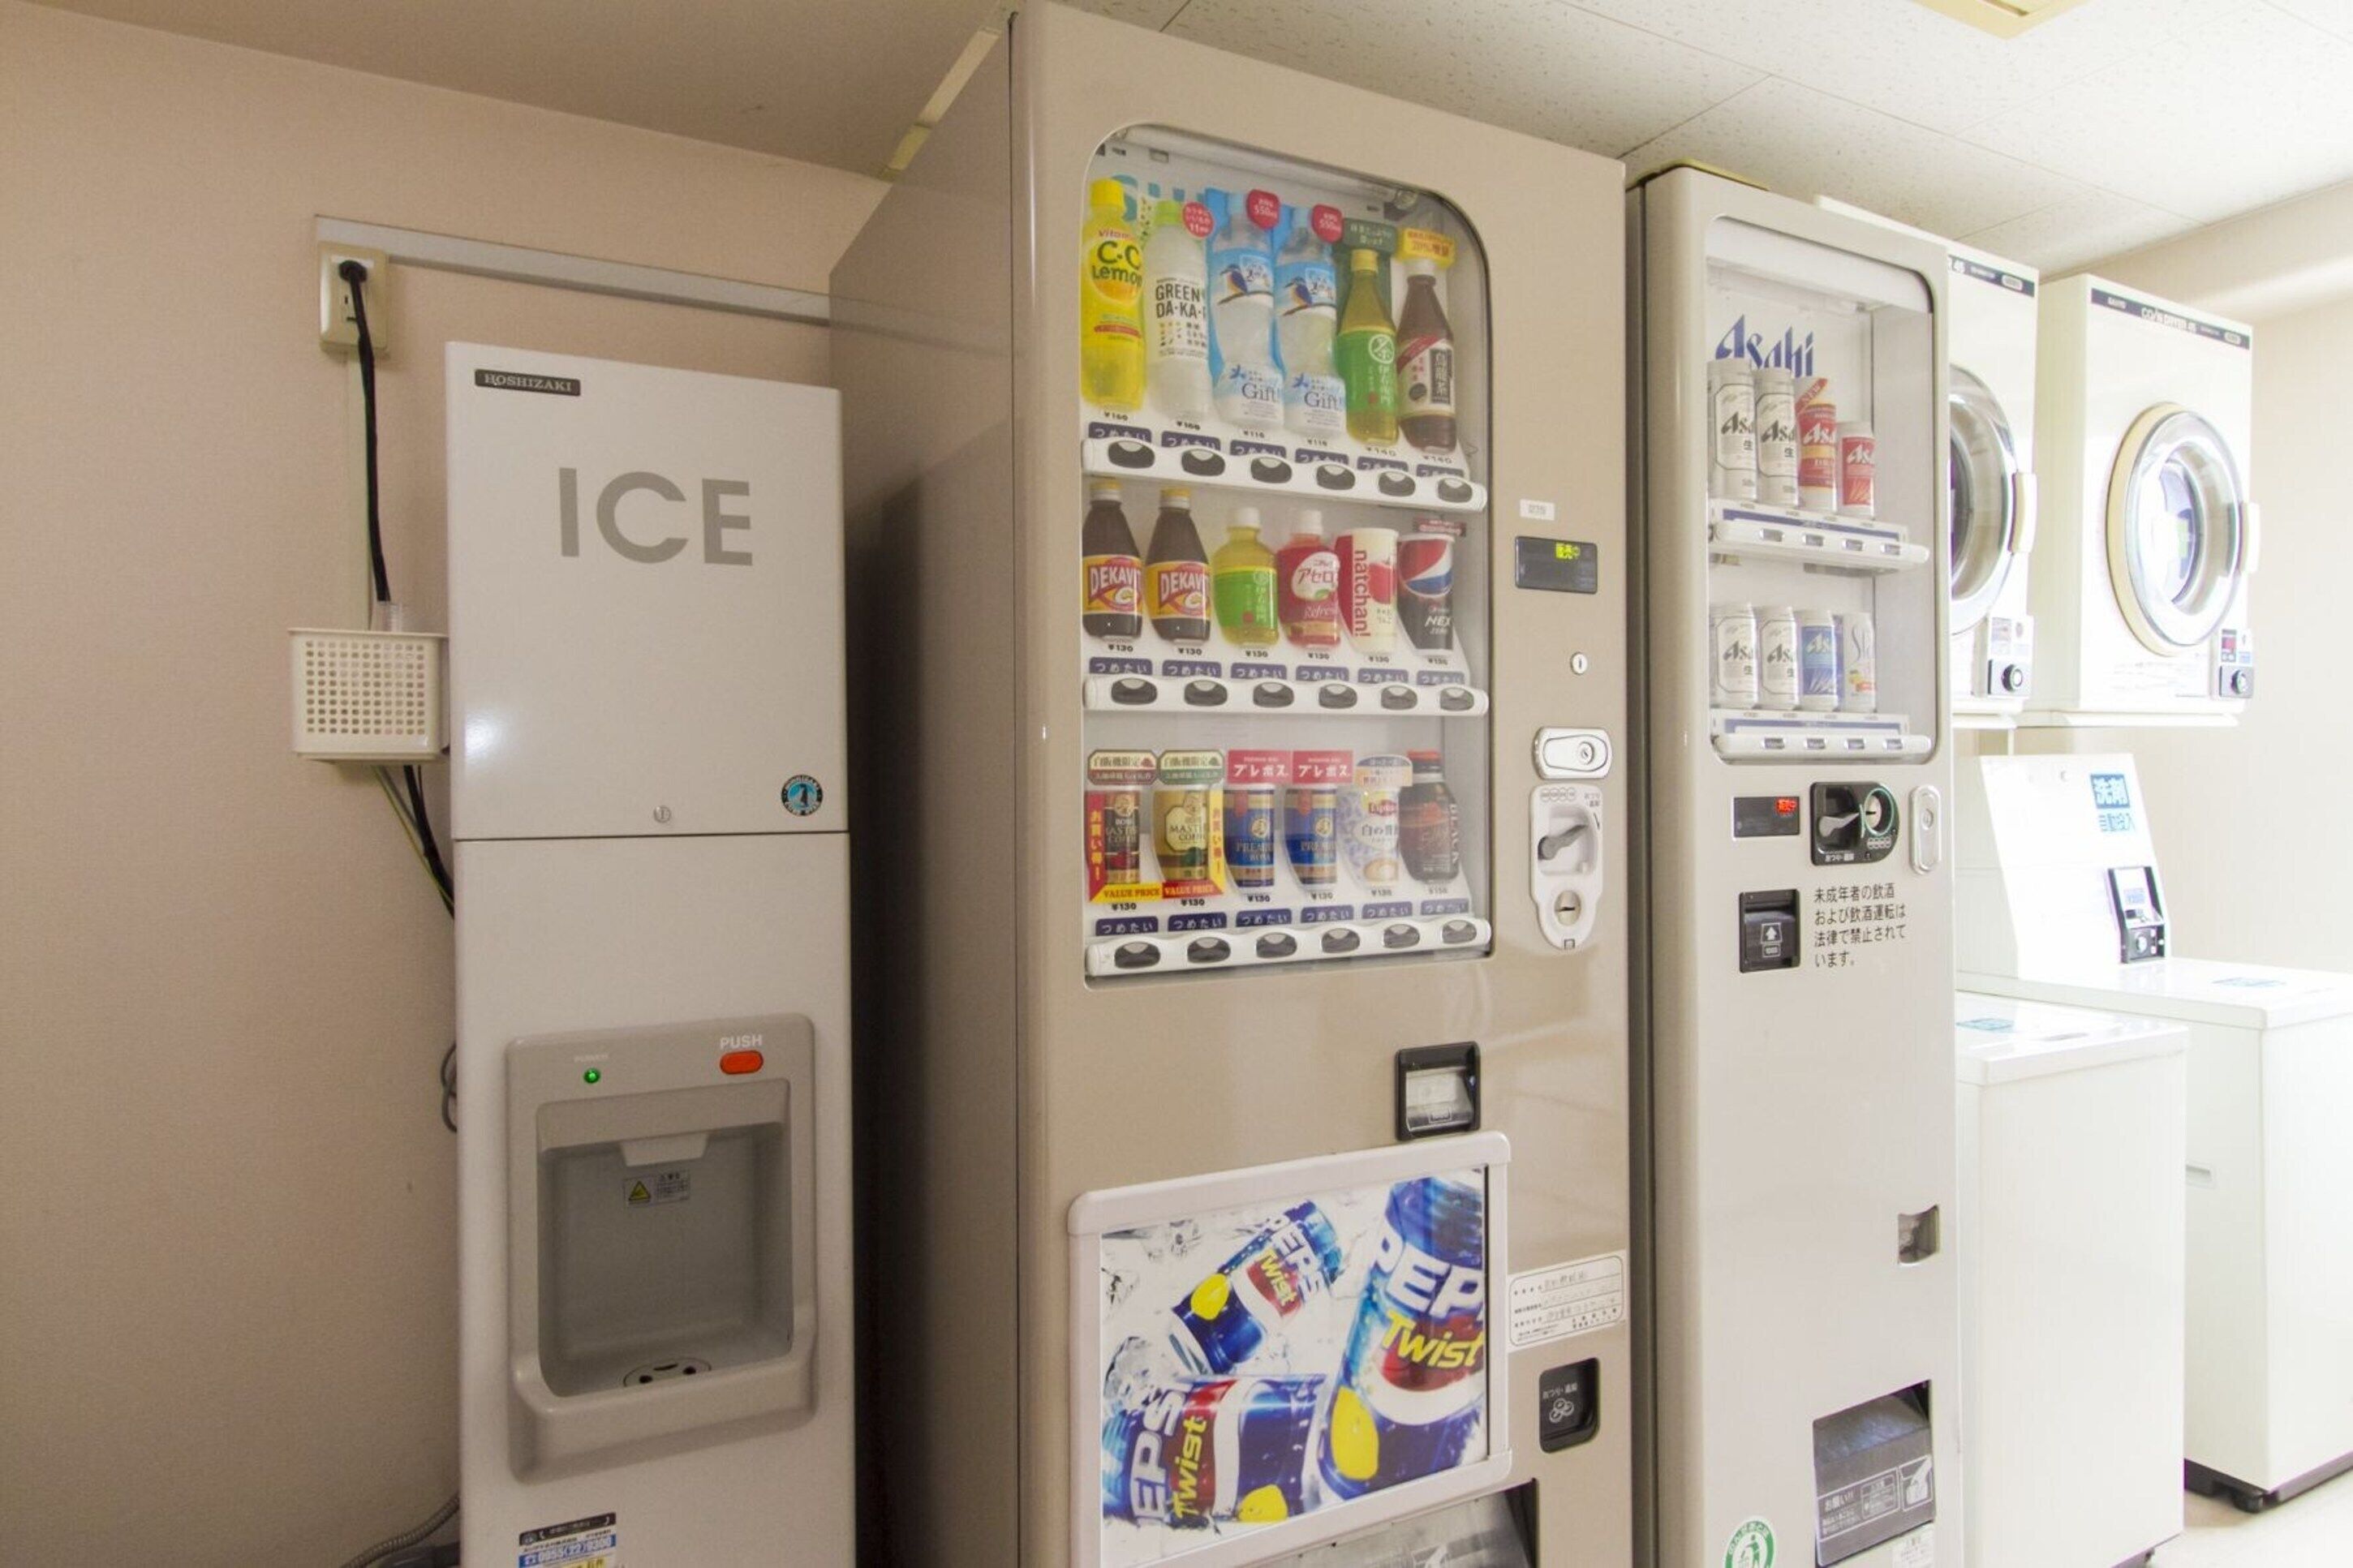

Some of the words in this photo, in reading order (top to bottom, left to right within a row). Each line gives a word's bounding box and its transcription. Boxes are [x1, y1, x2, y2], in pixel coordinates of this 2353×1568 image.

[1155, 283, 1201, 303] GREEN
[1714, 313, 1813, 378] Asahi
[484, 373, 572, 393] HOSHIZAKI
[559, 467, 753, 566] ICE
[1354, 549, 1370, 638] natchan!
[1424, 615, 1451, 627] NEX
[1108, 644, 1133, 653] ¥130
[1178, 648, 1202, 656] ¥130
[1245, 650, 1269, 658] ¥130
[1095, 661, 1147, 674] つめたい
[1168, 664, 1216, 676] つめたい
[1235, 668, 1283, 678] つめたい
[1300, 671, 1345, 681] つめたい
[1103, 888, 1133, 898] VALUE
[1247, 895, 1271, 903] ¥130
[1310, 892, 1333, 900] ¥130
[1814, 883, 1895, 903] 未成年者の飲酒
[1112, 903, 1137, 911] ¥130
[1181, 899, 1205, 907] ¥130
[1306, 910, 1349, 921] つめたい
[1366, 907, 1409, 917] つめたい
[1814, 904, 1906, 926] および飲酒運転は
[1173, 918, 1223, 930] つめたい
[1241, 914, 1288, 924] つめたい
[1101, 922, 1154, 934] つめたい
[1814, 925, 1907, 947] 法律で禁止されて
[1814, 952, 1856, 968] います。
[720, 1034, 764, 1050] PUSH
[1381, 1309, 1484, 1368] Twist
[1172, 1415, 1207, 1519] Twist
